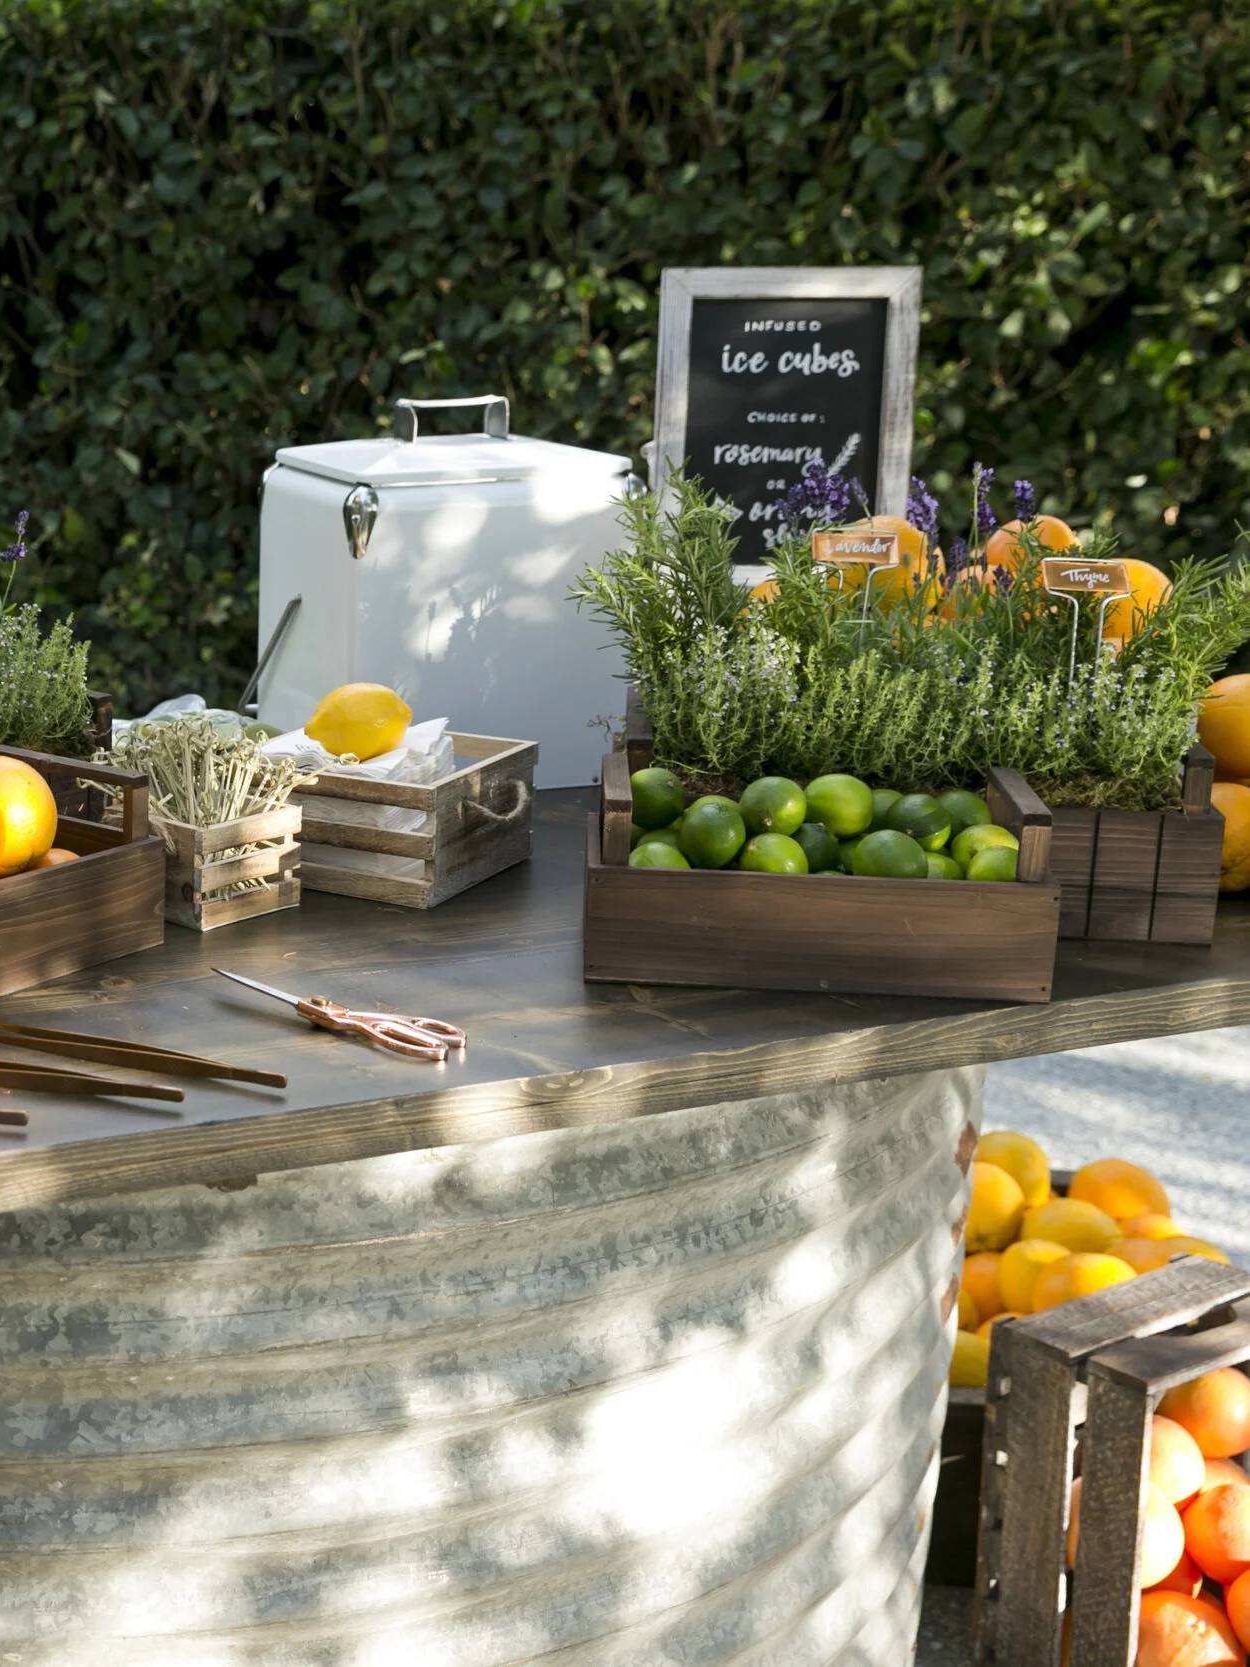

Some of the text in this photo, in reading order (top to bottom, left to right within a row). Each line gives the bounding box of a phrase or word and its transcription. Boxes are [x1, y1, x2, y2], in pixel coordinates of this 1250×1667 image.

[744, 319, 822, 333] INFUSED
[721, 341, 861, 378] ice cubes
[747, 411, 799, 424] CHOICE
[713, 443, 823, 478] rosemary
[766, 479, 786, 490] OR
[825, 537, 891, 555] Lavender
[1059, 567, 1111, 589] Thyme
